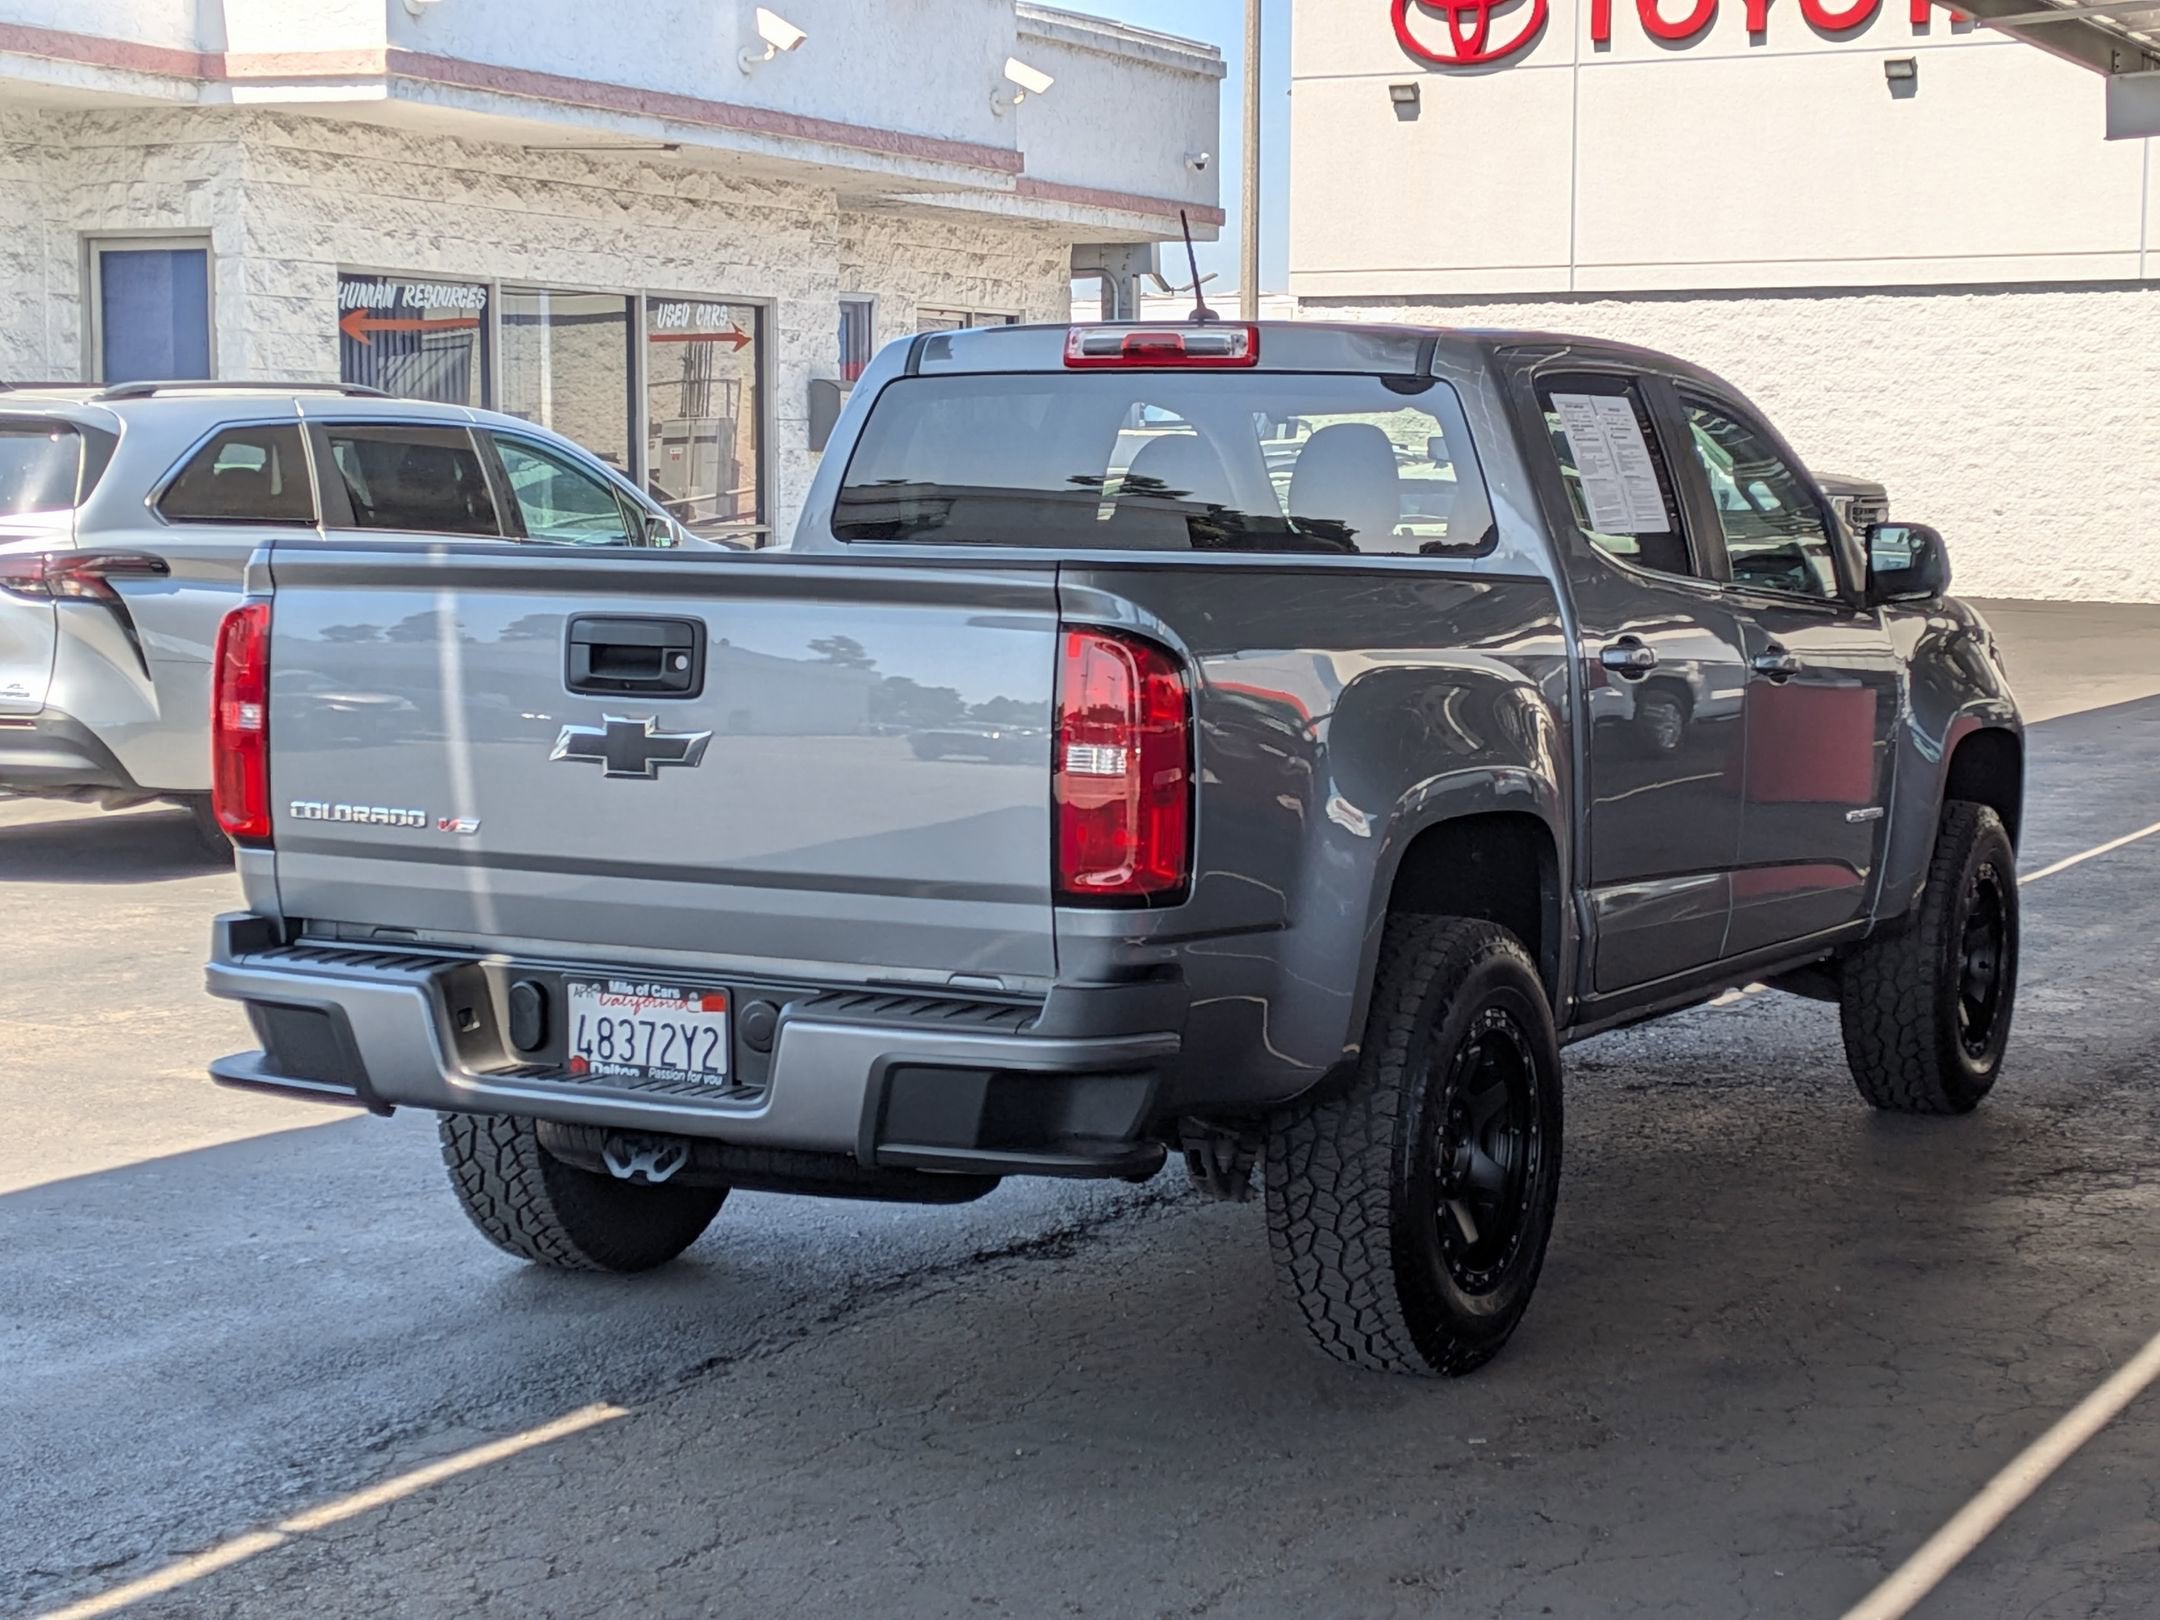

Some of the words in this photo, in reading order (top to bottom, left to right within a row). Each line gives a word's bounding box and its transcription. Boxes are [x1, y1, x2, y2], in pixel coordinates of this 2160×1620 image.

[337, 281, 397, 310] HUMAN
[401, 283, 487, 310] RESOURCES
[657, 302, 690, 329] USED
[696, 303, 728, 327] CARS
[289, 801, 428, 828] COLORADO
[608, 980, 634, 995] Mile
[635, 983, 650, 997] of
[651, 984, 681, 999] Cars
[577, 1014, 719, 1075] 48372Y2
[648, 1067, 686, 1082] Passion
[687, 1069, 702, 1084] for
